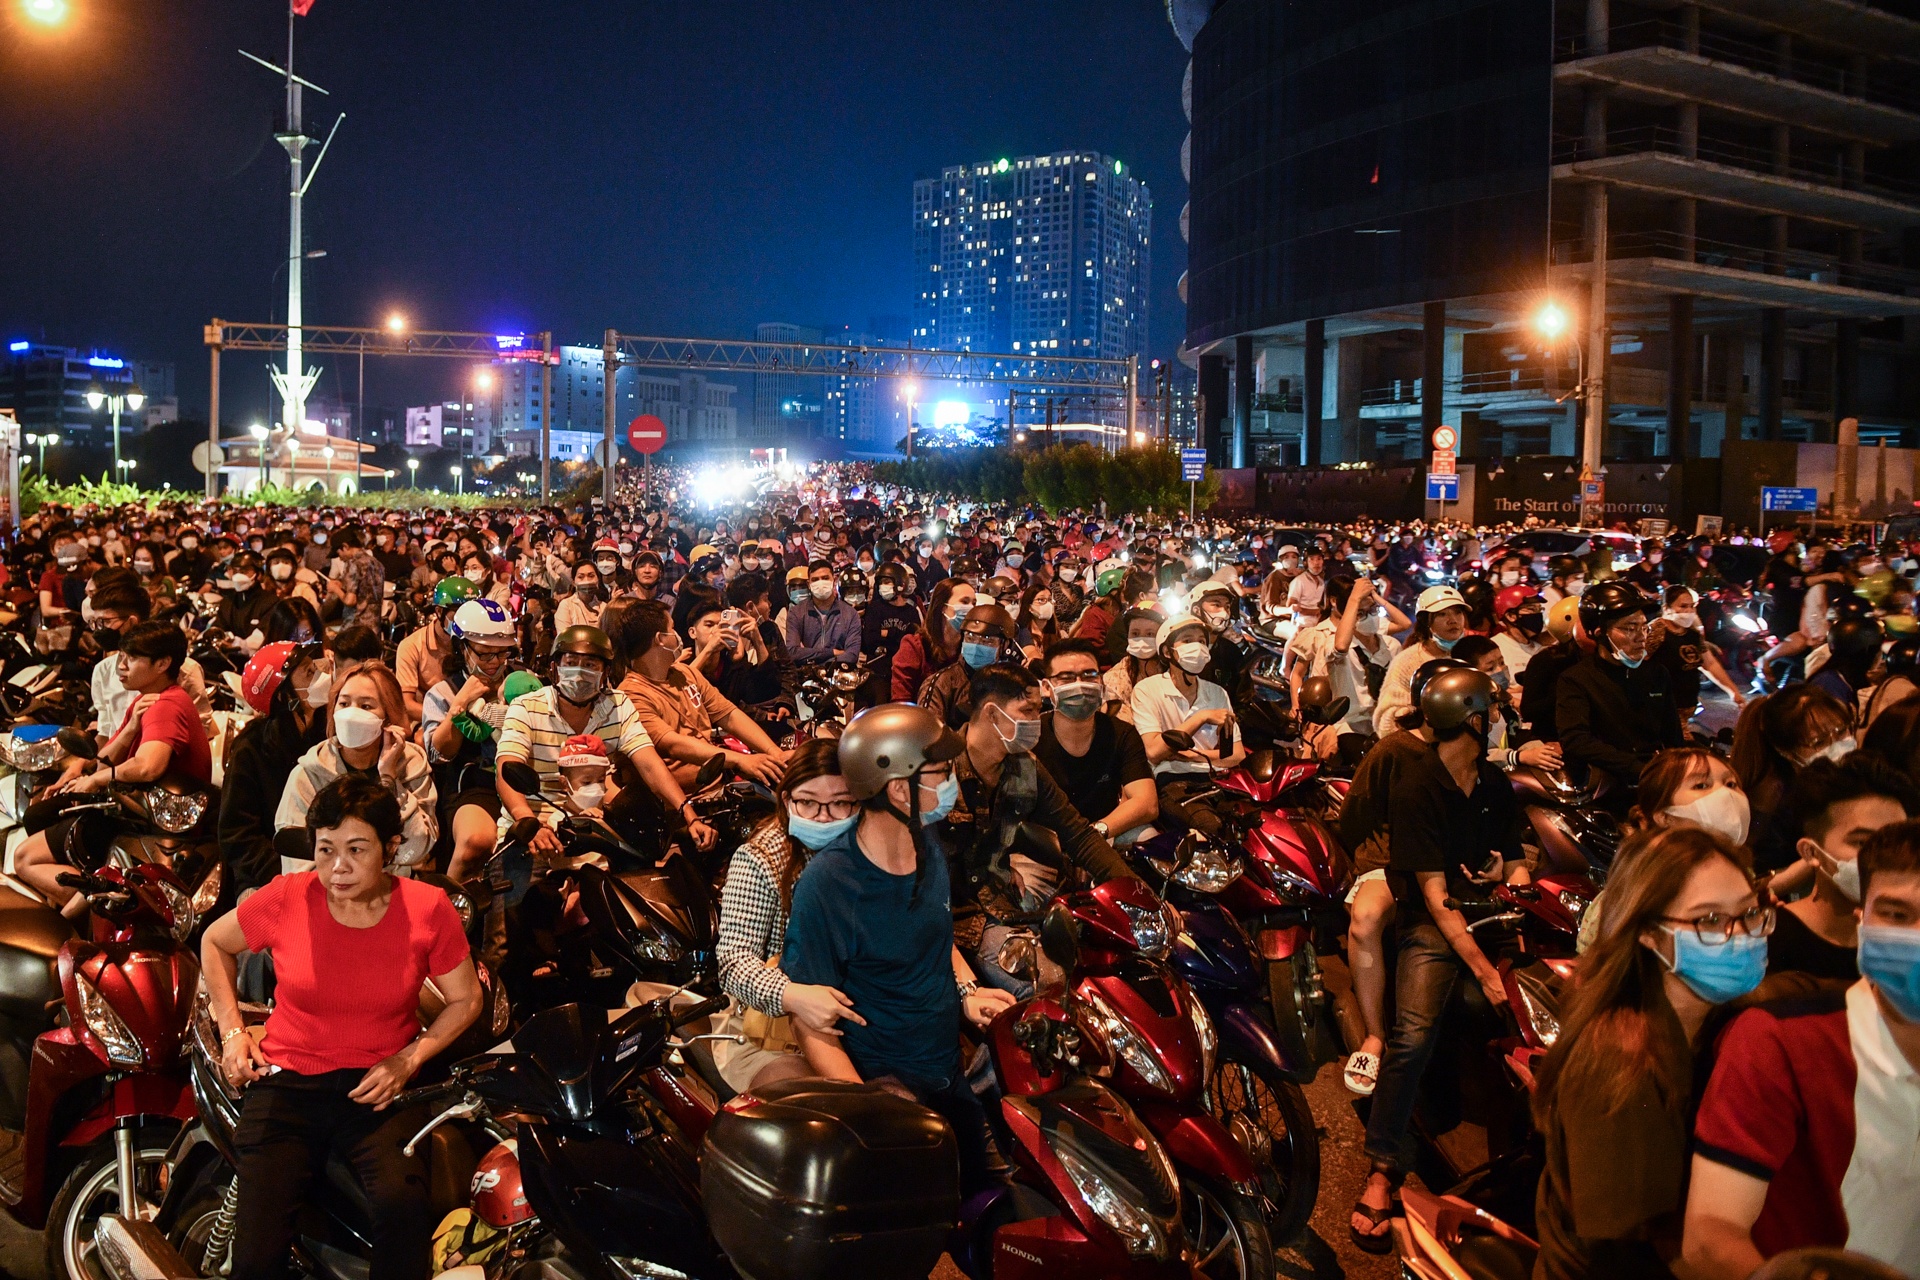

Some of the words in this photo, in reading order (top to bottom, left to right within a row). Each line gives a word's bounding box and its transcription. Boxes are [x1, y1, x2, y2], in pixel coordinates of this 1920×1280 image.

[1494, 498, 1521, 511] The
[1523, 498, 1558, 512] Start
[1353, 1056, 1370, 1070] NY
[471, 1170, 501, 1197] GP
[1002, 1242, 1044, 1265] HONDA
